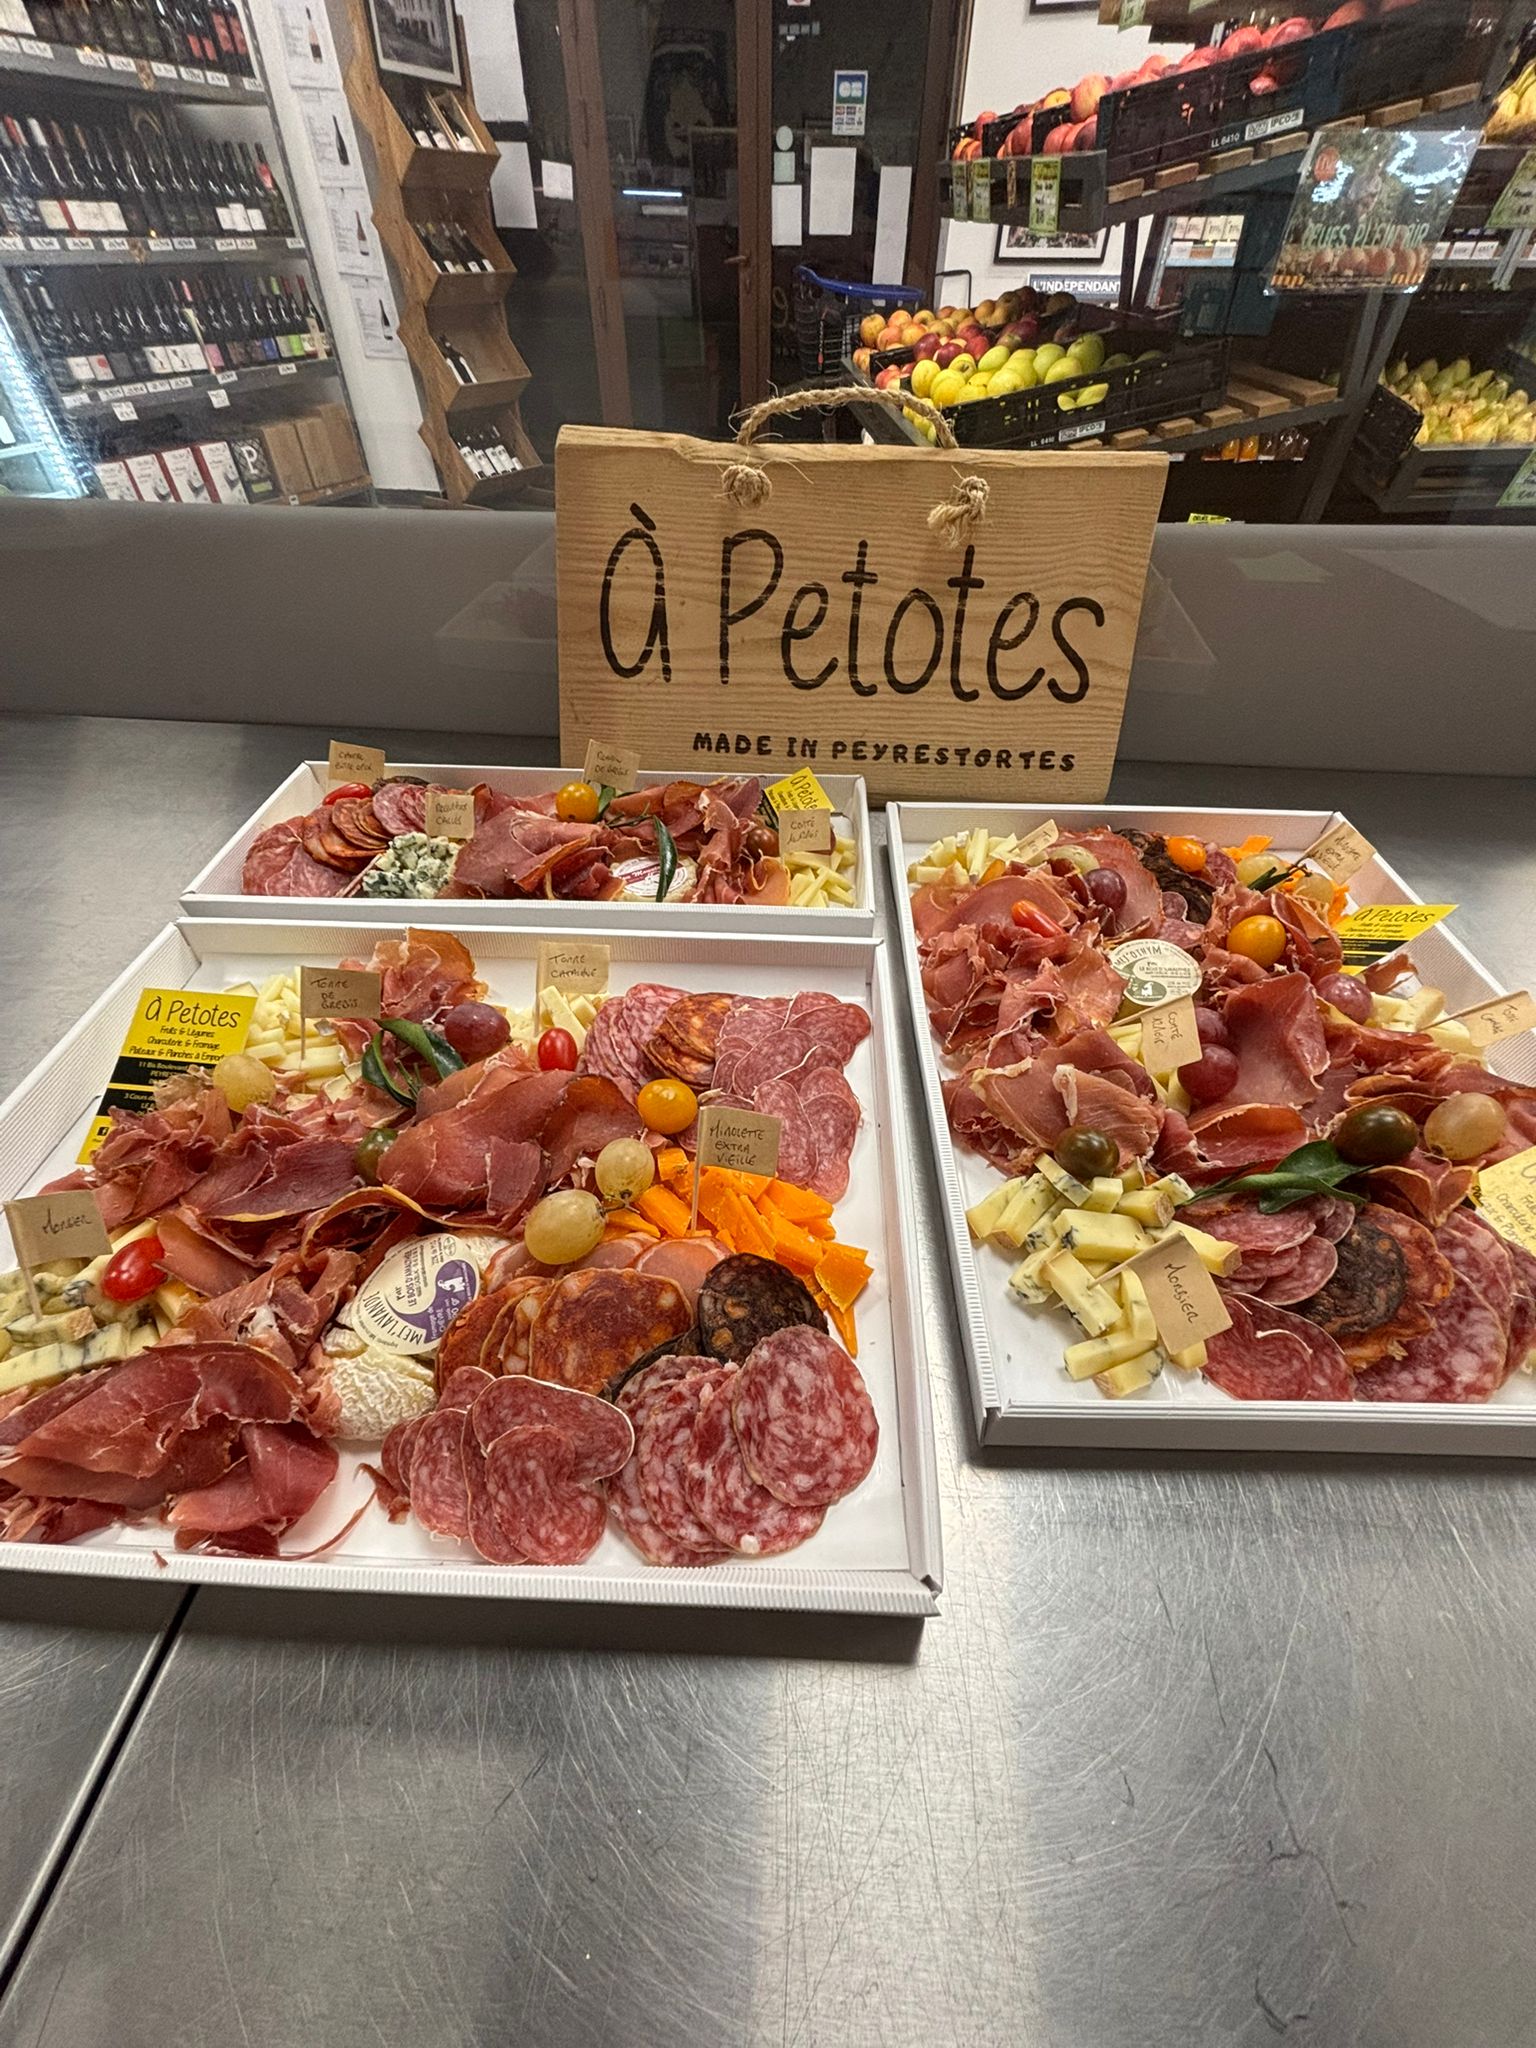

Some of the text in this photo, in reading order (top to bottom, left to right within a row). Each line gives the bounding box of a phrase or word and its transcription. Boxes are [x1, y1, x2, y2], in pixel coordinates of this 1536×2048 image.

[720, 529, 1105, 704] Petotes
[692, 732, 1076, 772] MADE IN PEYRESTORTES
[794, 783, 818, 809] Petote
[1369, 910, 1435, 922] Petotes
[167, 1000, 241, 1028] Petotes
[193, 1040, 220, 1051] Fromage
